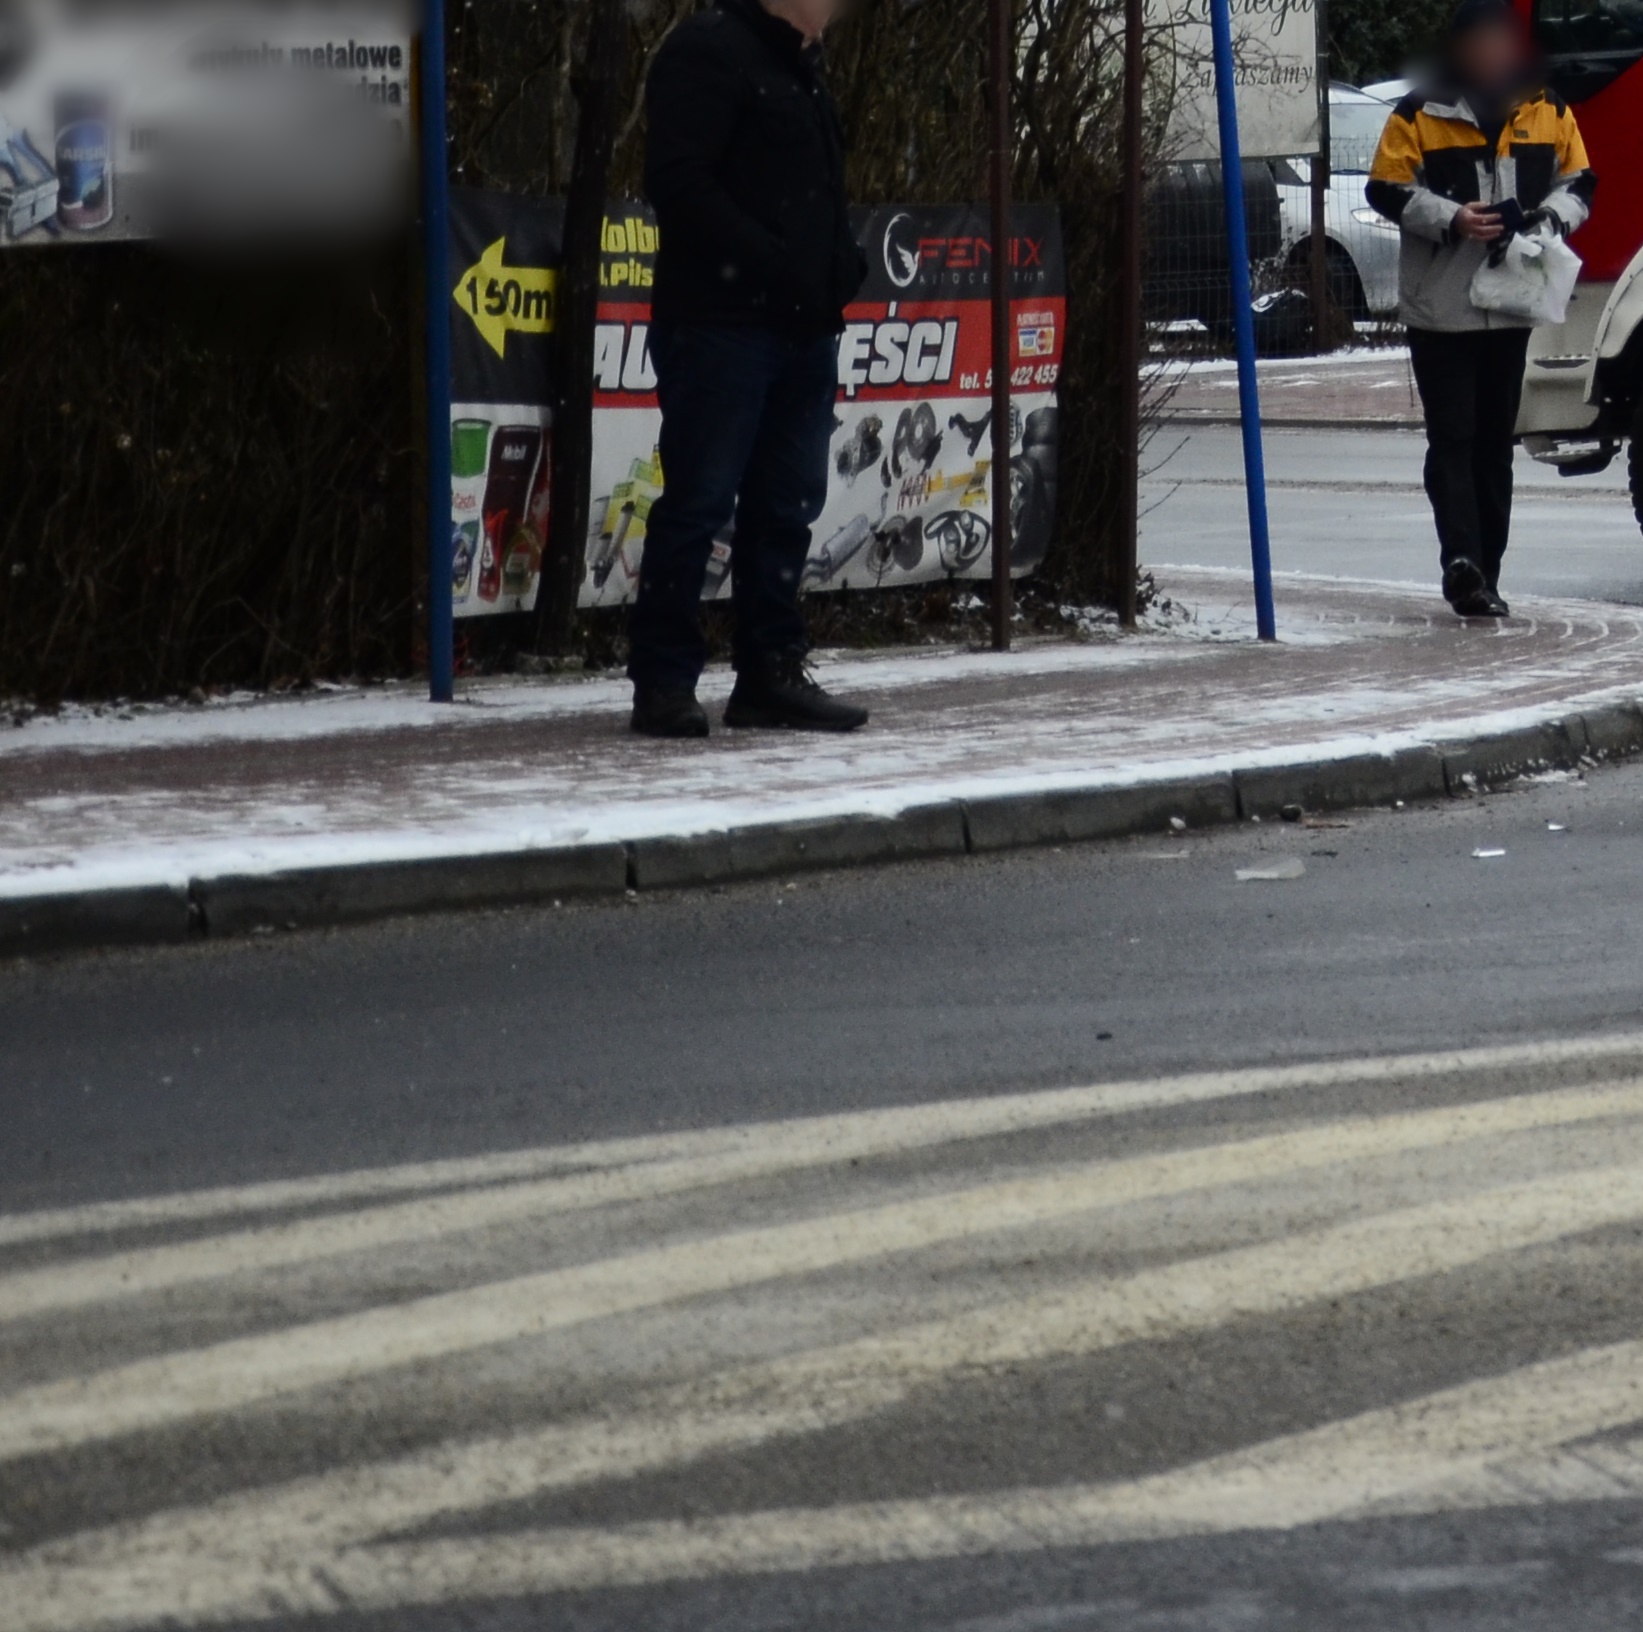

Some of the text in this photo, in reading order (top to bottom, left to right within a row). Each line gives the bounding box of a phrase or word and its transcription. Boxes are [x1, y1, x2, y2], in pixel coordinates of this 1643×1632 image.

[290, 40, 402, 71] metalowe
[610, 258, 654, 287] Pils
[466, 275, 552, 321] 150m
[594, 301, 958, 397] AU ĘŚCI
[960, 372, 981, 390] tel.
[1011, 366, 1033, 386] 422
[1034, 364, 1058, 384] 455
